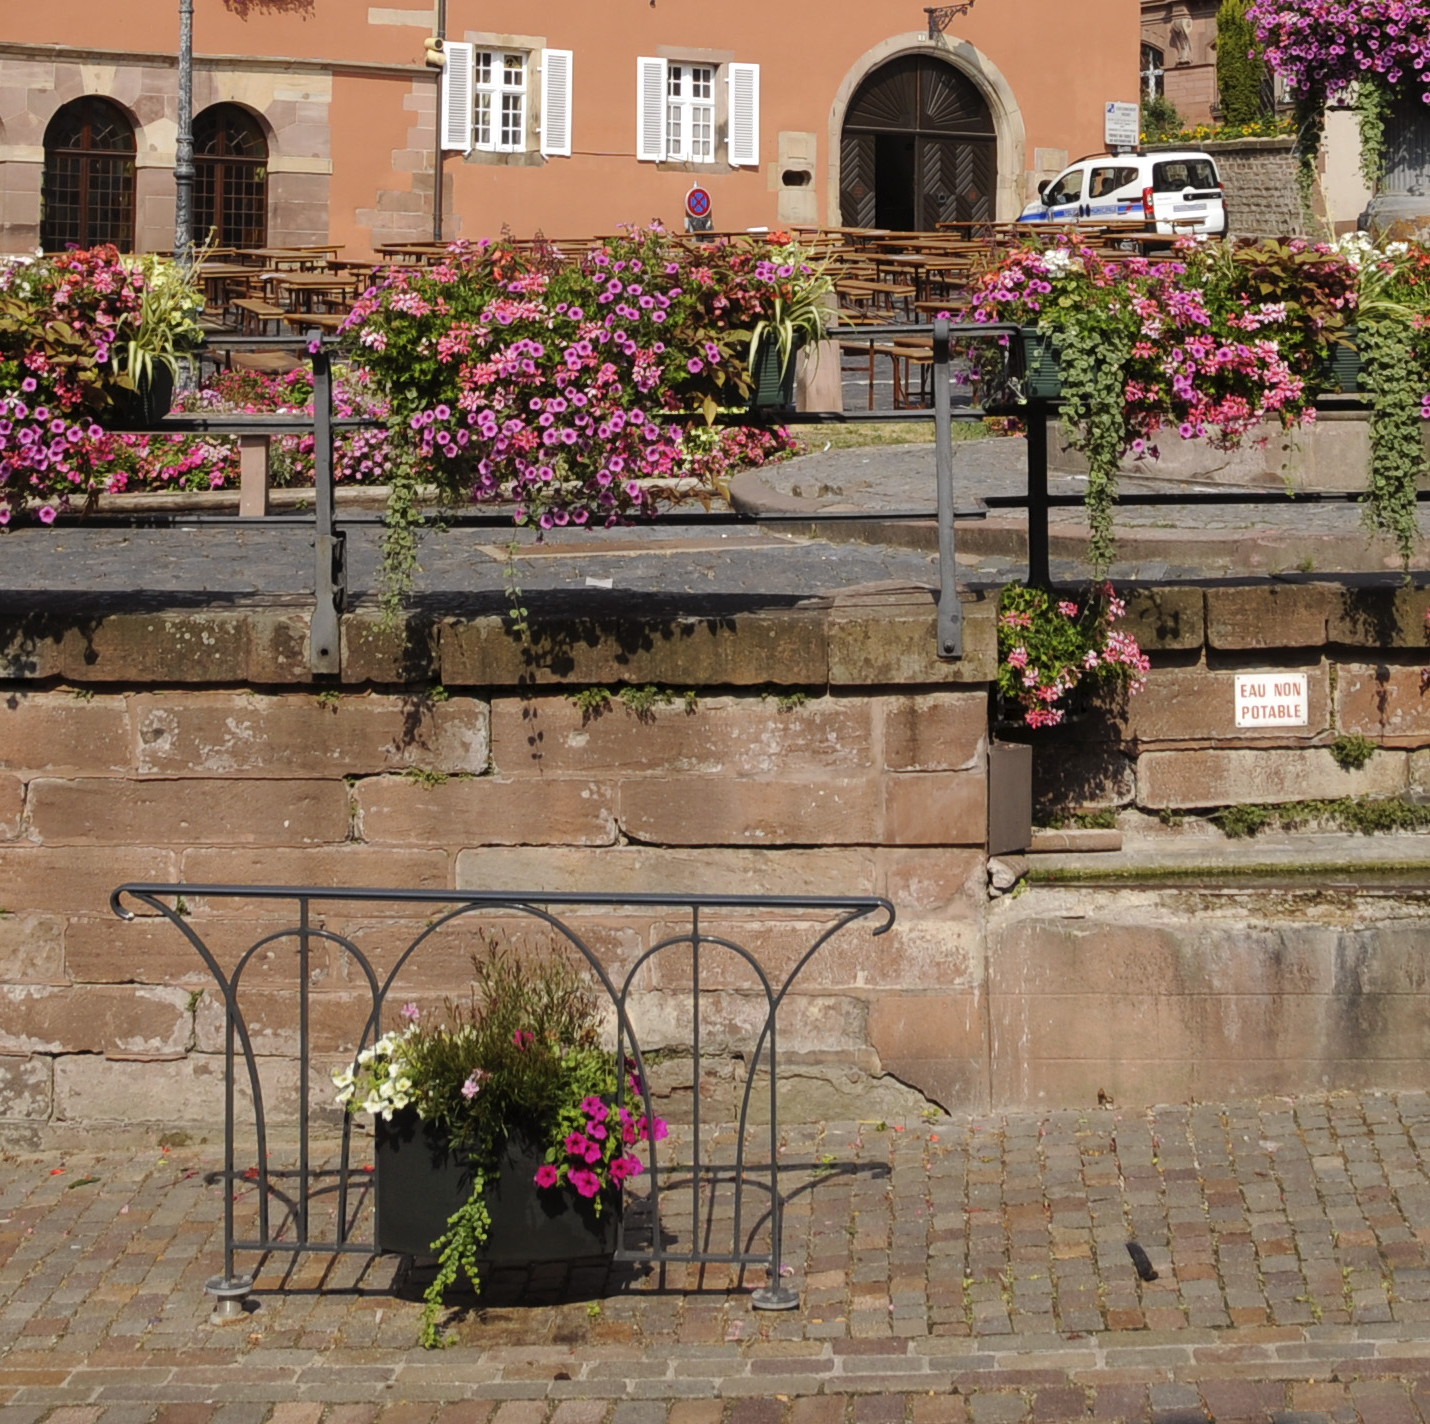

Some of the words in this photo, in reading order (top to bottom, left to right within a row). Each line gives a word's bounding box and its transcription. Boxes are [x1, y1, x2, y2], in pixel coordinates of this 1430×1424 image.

[1240, 683, 1266, 698] EAU
[1274, 682, 1301, 697] NON
[1241, 704, 1302, 719] POTABLE
